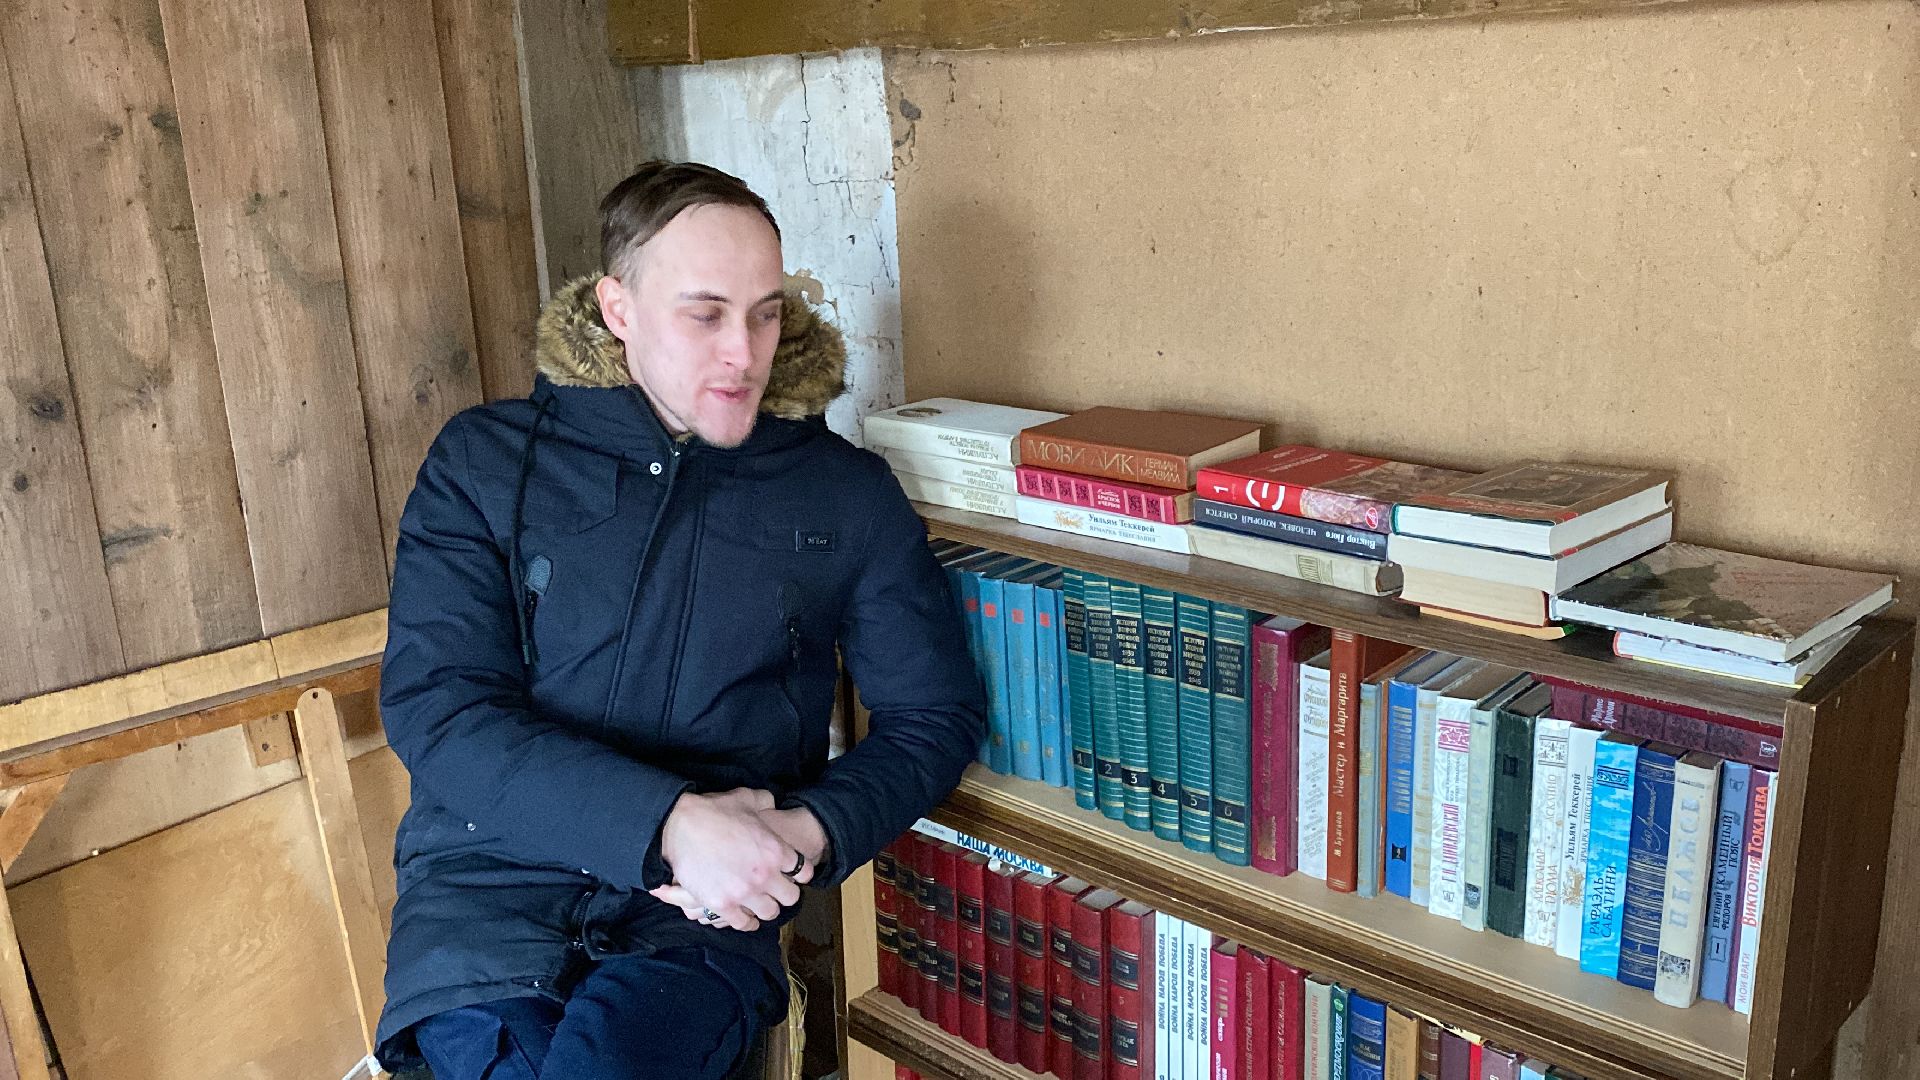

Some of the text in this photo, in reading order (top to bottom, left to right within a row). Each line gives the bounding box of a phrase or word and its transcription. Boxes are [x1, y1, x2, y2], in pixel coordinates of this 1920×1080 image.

[1026, 439, 1086, 464] МОБИ
[1145, 457, 1178, 472] ГЕРМАН
[1088, 513, 1155, 532] Уильям Теккерей
[1205, 507, 1238, 521] СМЕЕТСЯ
[1241, 514, 1276, 529] КОТОРЫЙ
[1325, 531, 1376, 549] Виктор Гюго
[1116, 619, 1138, 627] ИСТОРИЯ
[1332, 672, 1349, 797] Мастер и Маргарита
[1077, 754, 1083, 765] 1
[1104, 764, 1113, 775] 2
[1130, 773, 1138, 784] 3
[1157, 783, 1166, 795] 4
[1190, 795, 1198, 807] 5
[1224, 806, 1232, 817] 6
[1334, 811, 1343, 847] Булгаков
[1565, 773, 1581, 861] Уильям Теккерей
[957, 831, 1044, 874] НАША МОСКВА
[1716, 814, 1733, 885] КАМЕННЫЙ
[1728, 838, 1740, 868] ПОЯС
[1741, 786, 1769, 928] ВИКТОРИЯ ТОКАРЕВА
[1545, 864, 1558, 905] ДЮМА
[1589, 877, 1605, 935] РАФАЭЛЬ
[1601, 865, 1617, 938] САБАТИНИ
[1711, 892, 1723, 929] ЕВГЕНИЙ
[1721, 894, 1732, 930] ФЕДОРОВ
[1738, 953, 1751, 1004] МОИ ВРАГИ
[1158, 1002, 1166, 1030] ВОЙНА
[1200, 1017, 1208, 1046] ВОЙНА
[1333, 1012, 1345, 1080] ОДМОСКОВЬЕ
